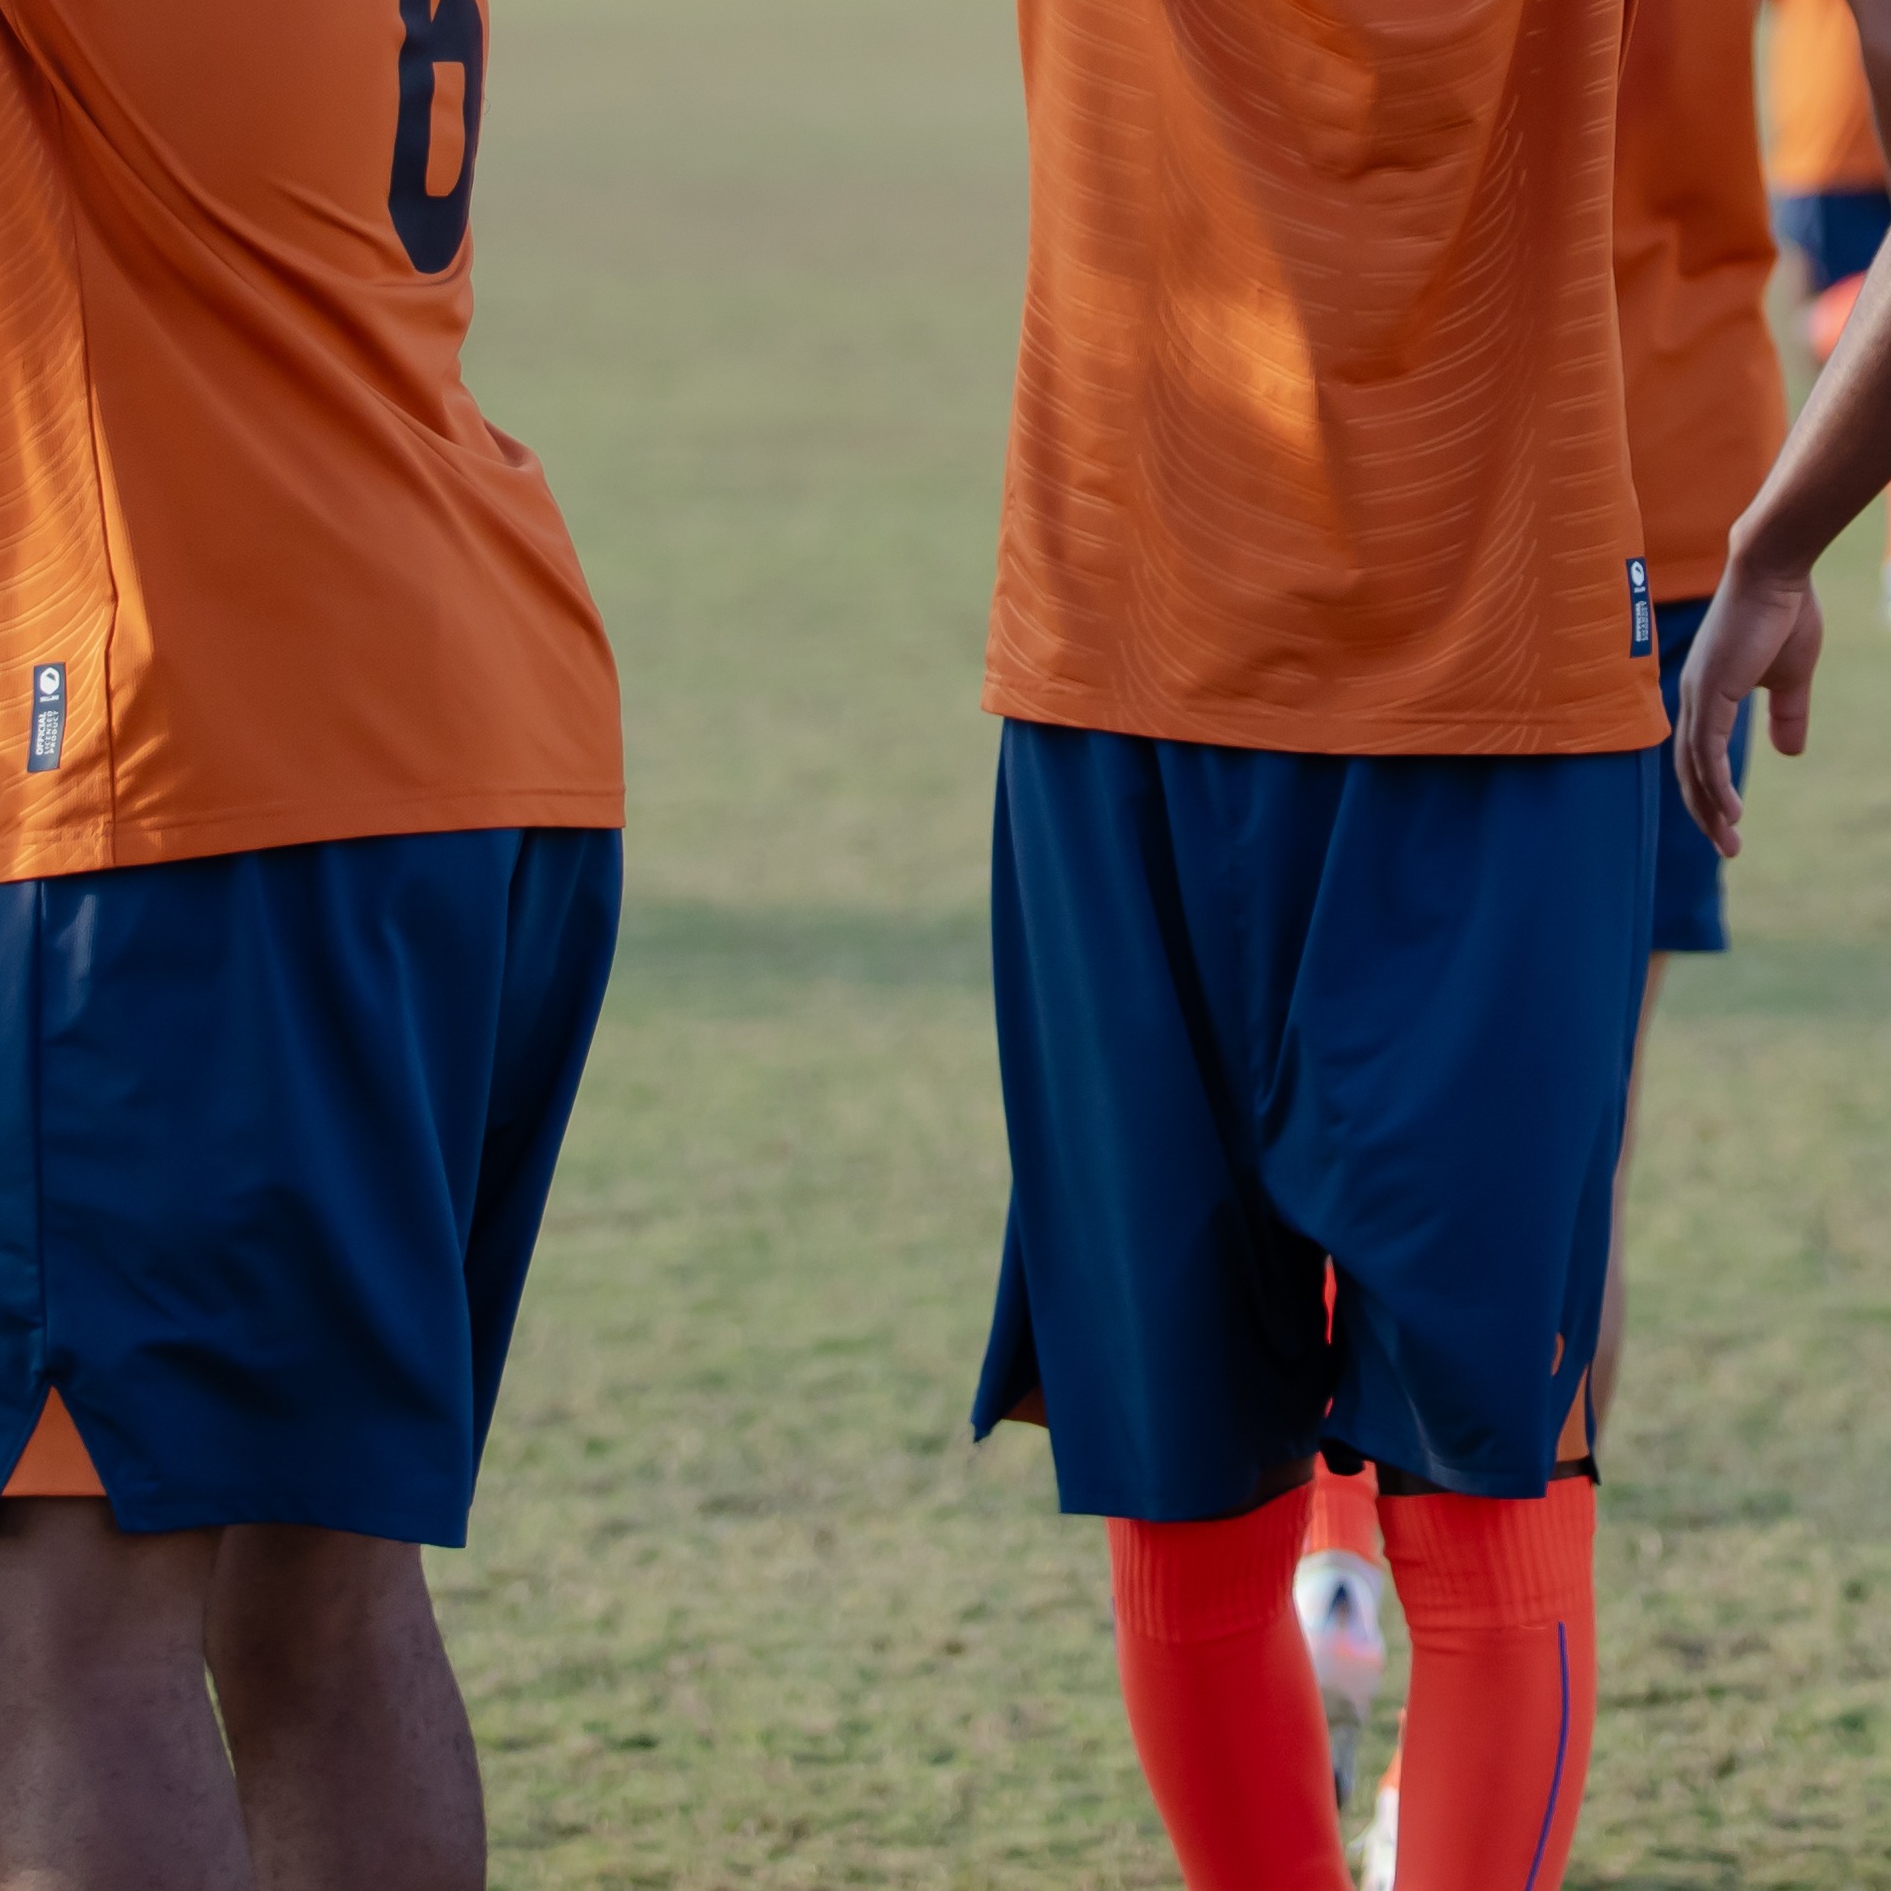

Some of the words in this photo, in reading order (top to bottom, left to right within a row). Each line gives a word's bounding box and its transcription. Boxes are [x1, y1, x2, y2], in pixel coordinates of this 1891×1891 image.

[35, 712, 47, 756] OFFICIAL
[44, 710, 54, 754] LICENSED
[48, 710, 59, 754] PRODUCT
